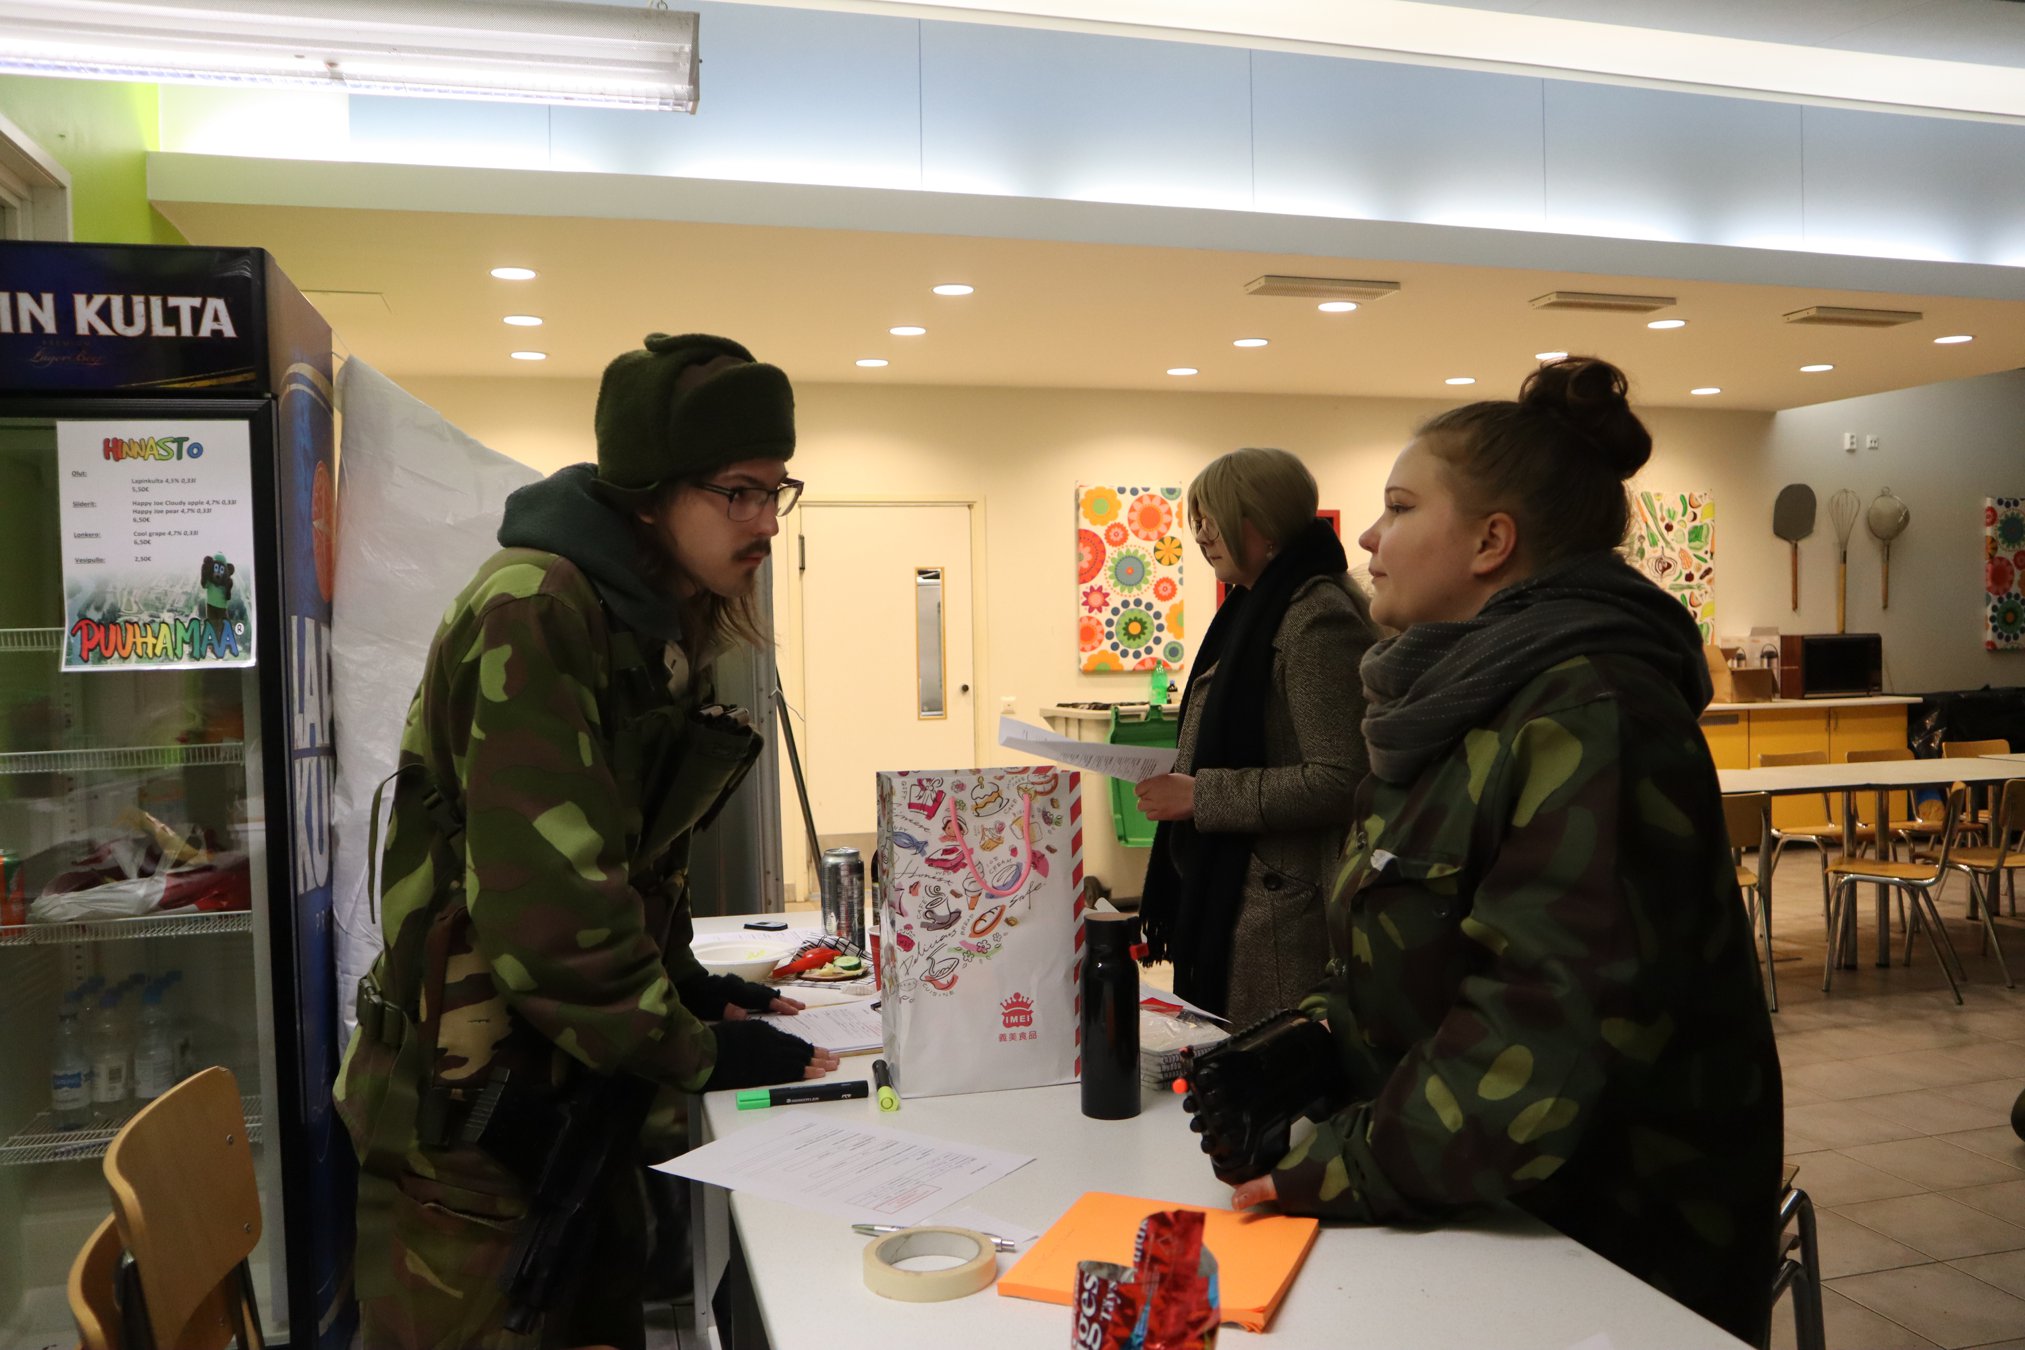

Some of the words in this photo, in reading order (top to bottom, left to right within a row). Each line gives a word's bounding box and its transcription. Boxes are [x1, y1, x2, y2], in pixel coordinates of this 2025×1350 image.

[72, 293, 238, 338] KULTA
[103, 436, 204, 461] HINNASTO
[71, 617, 239, 663] PUUHAMAA
[1004, 1014, 1032, 1025] IMEI
